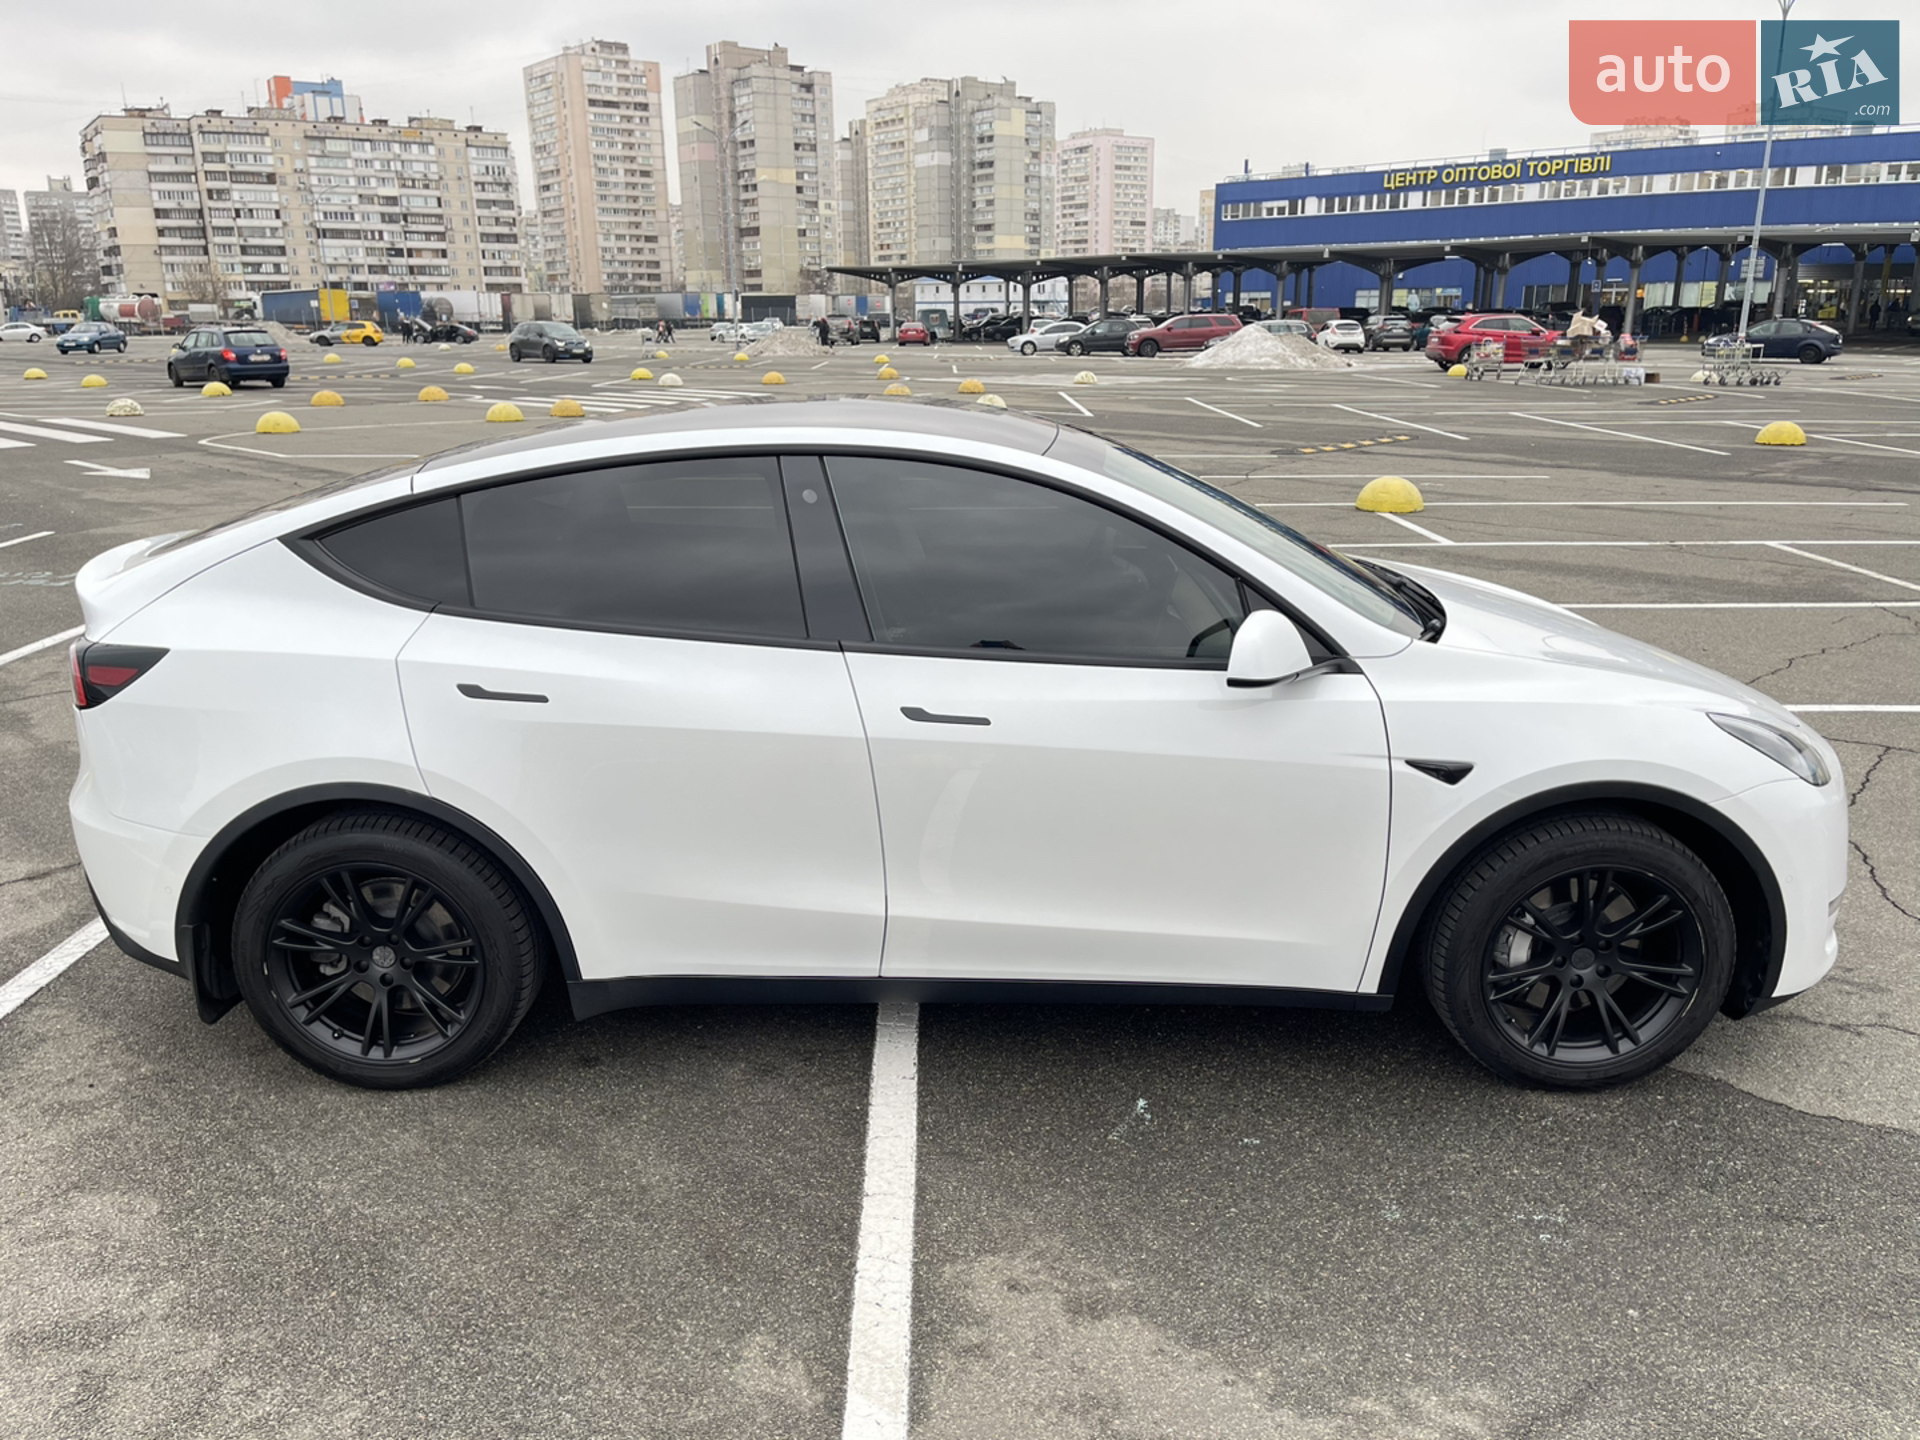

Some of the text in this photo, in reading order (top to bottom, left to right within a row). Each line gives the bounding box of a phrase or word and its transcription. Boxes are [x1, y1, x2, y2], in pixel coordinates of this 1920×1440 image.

[1383, 155, 1612, 190] ЦЕНТР ОПТОВОЇ ТОРГІВЛІ
